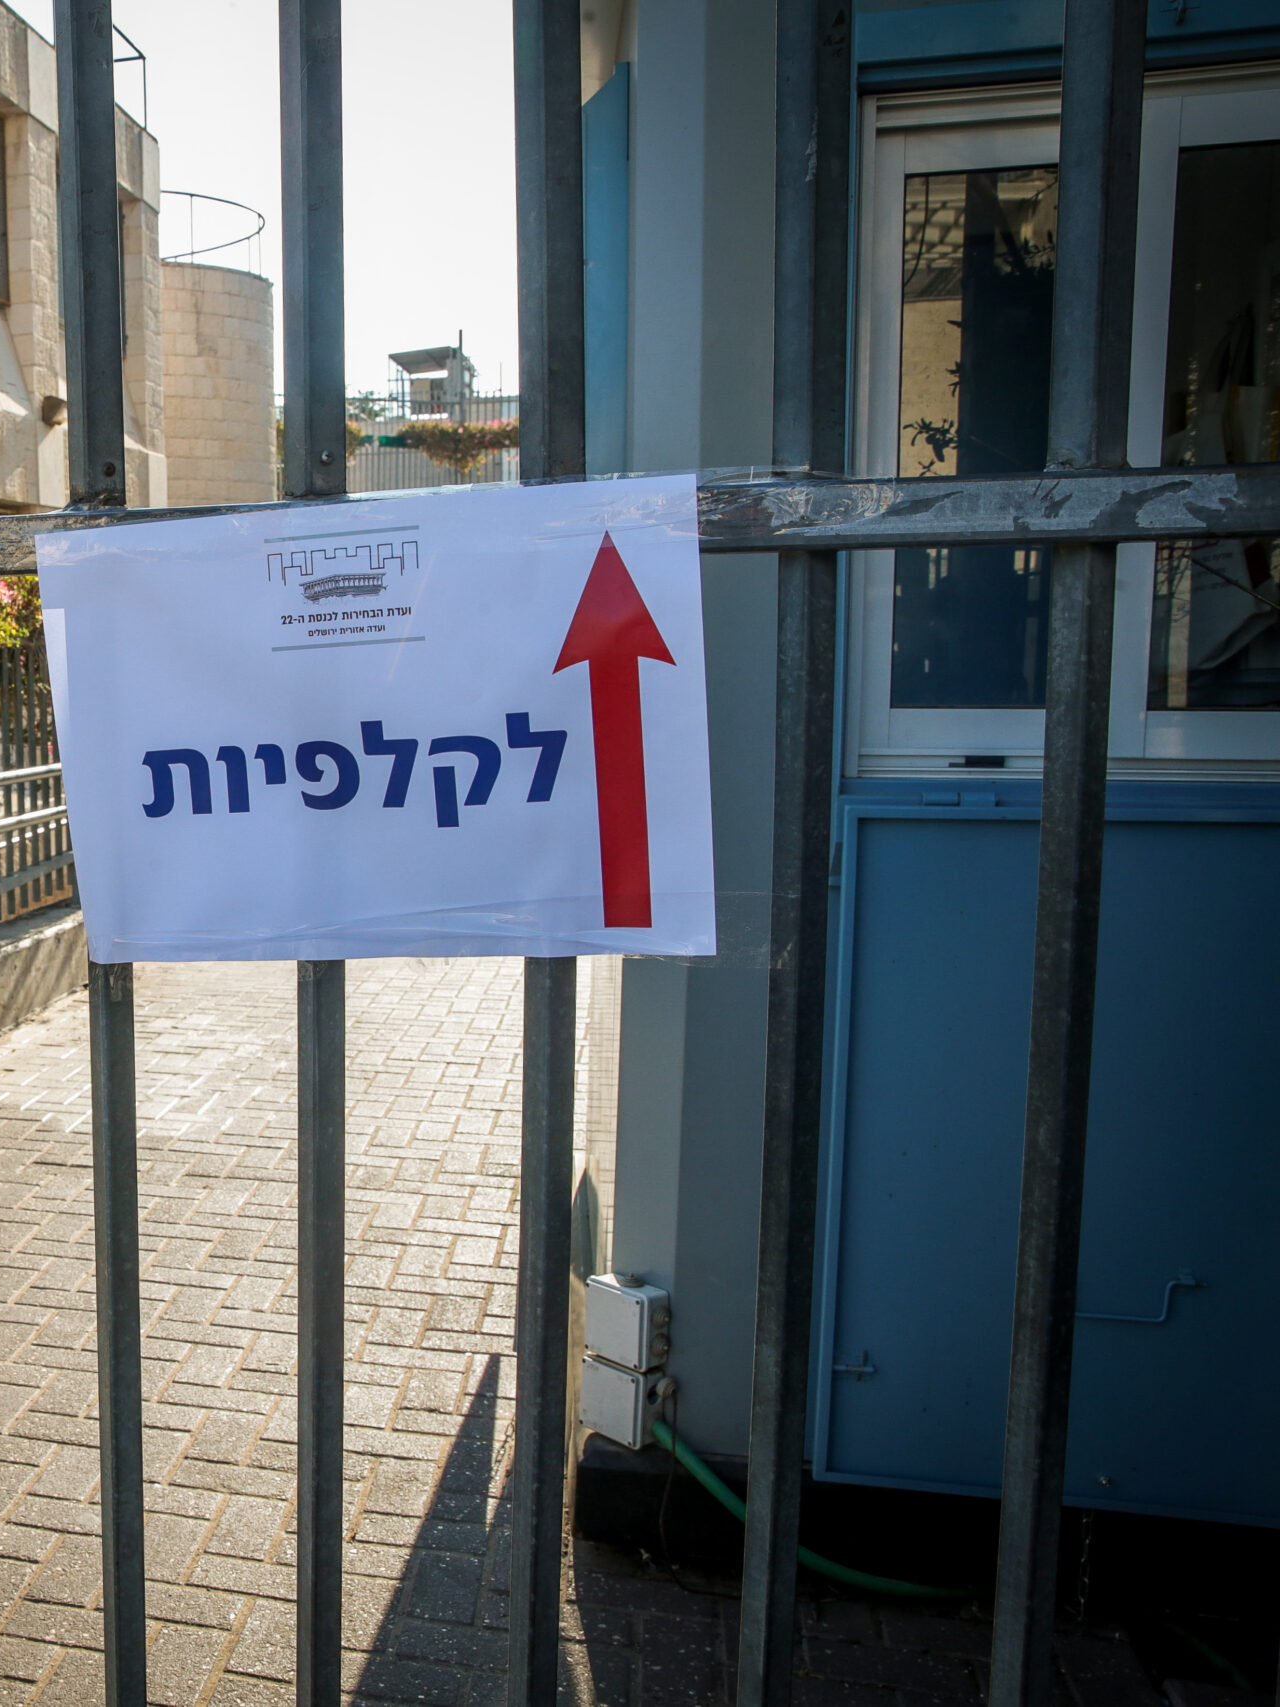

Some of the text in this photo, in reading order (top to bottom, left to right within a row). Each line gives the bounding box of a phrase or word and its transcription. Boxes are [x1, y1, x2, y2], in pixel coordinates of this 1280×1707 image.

[308, 611, 338, 623] לכנסת
[341, 608, 384, 620] הבחירות
[387, 606, 412, 617] ועדת
[308, 624, 386, 637] ועדה אזורית ירושלים
[141, 711, 568, 829] לקלפיות
